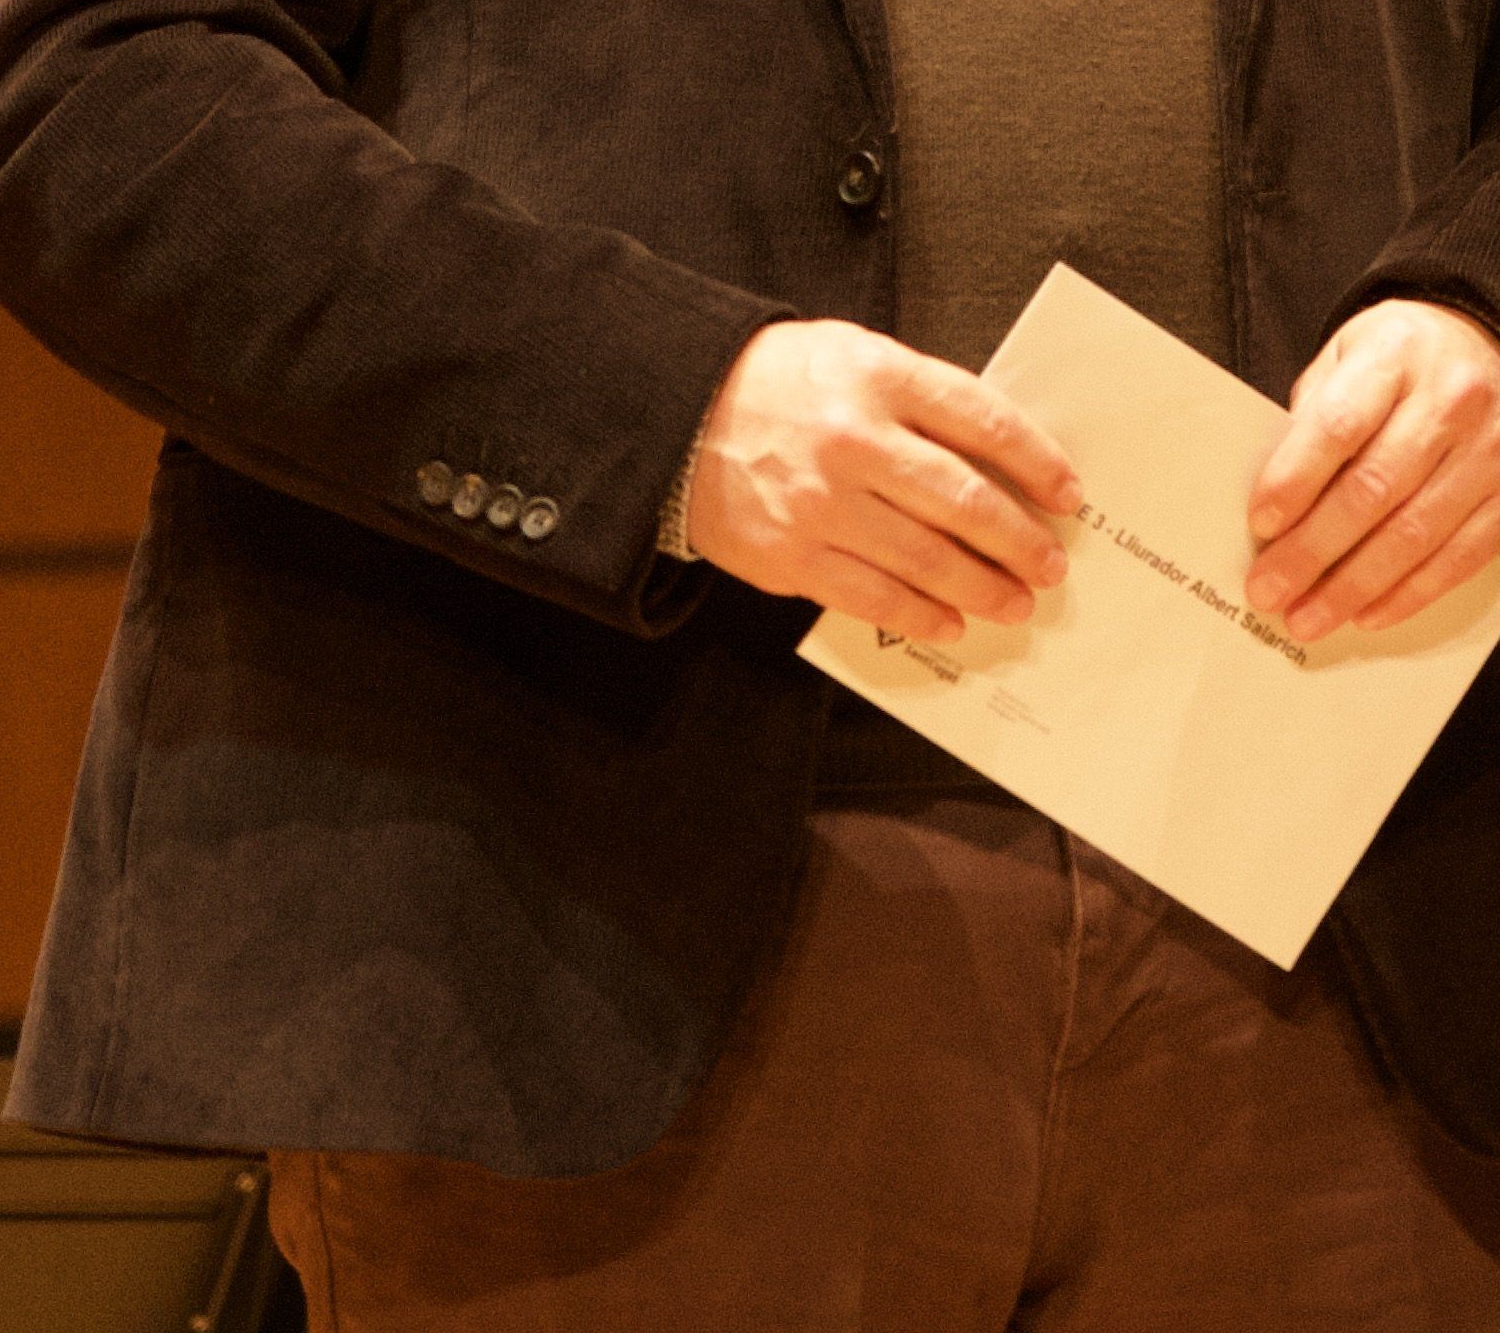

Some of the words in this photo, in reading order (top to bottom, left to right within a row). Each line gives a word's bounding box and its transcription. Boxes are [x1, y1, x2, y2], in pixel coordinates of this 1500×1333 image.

[1092, 514, 1107, 531] 3
[1114, 529, 1190, 586] Lliurador
[1188, 579, 1241, 622] Albert
[1240, 611, 1308, 666] Salarich
